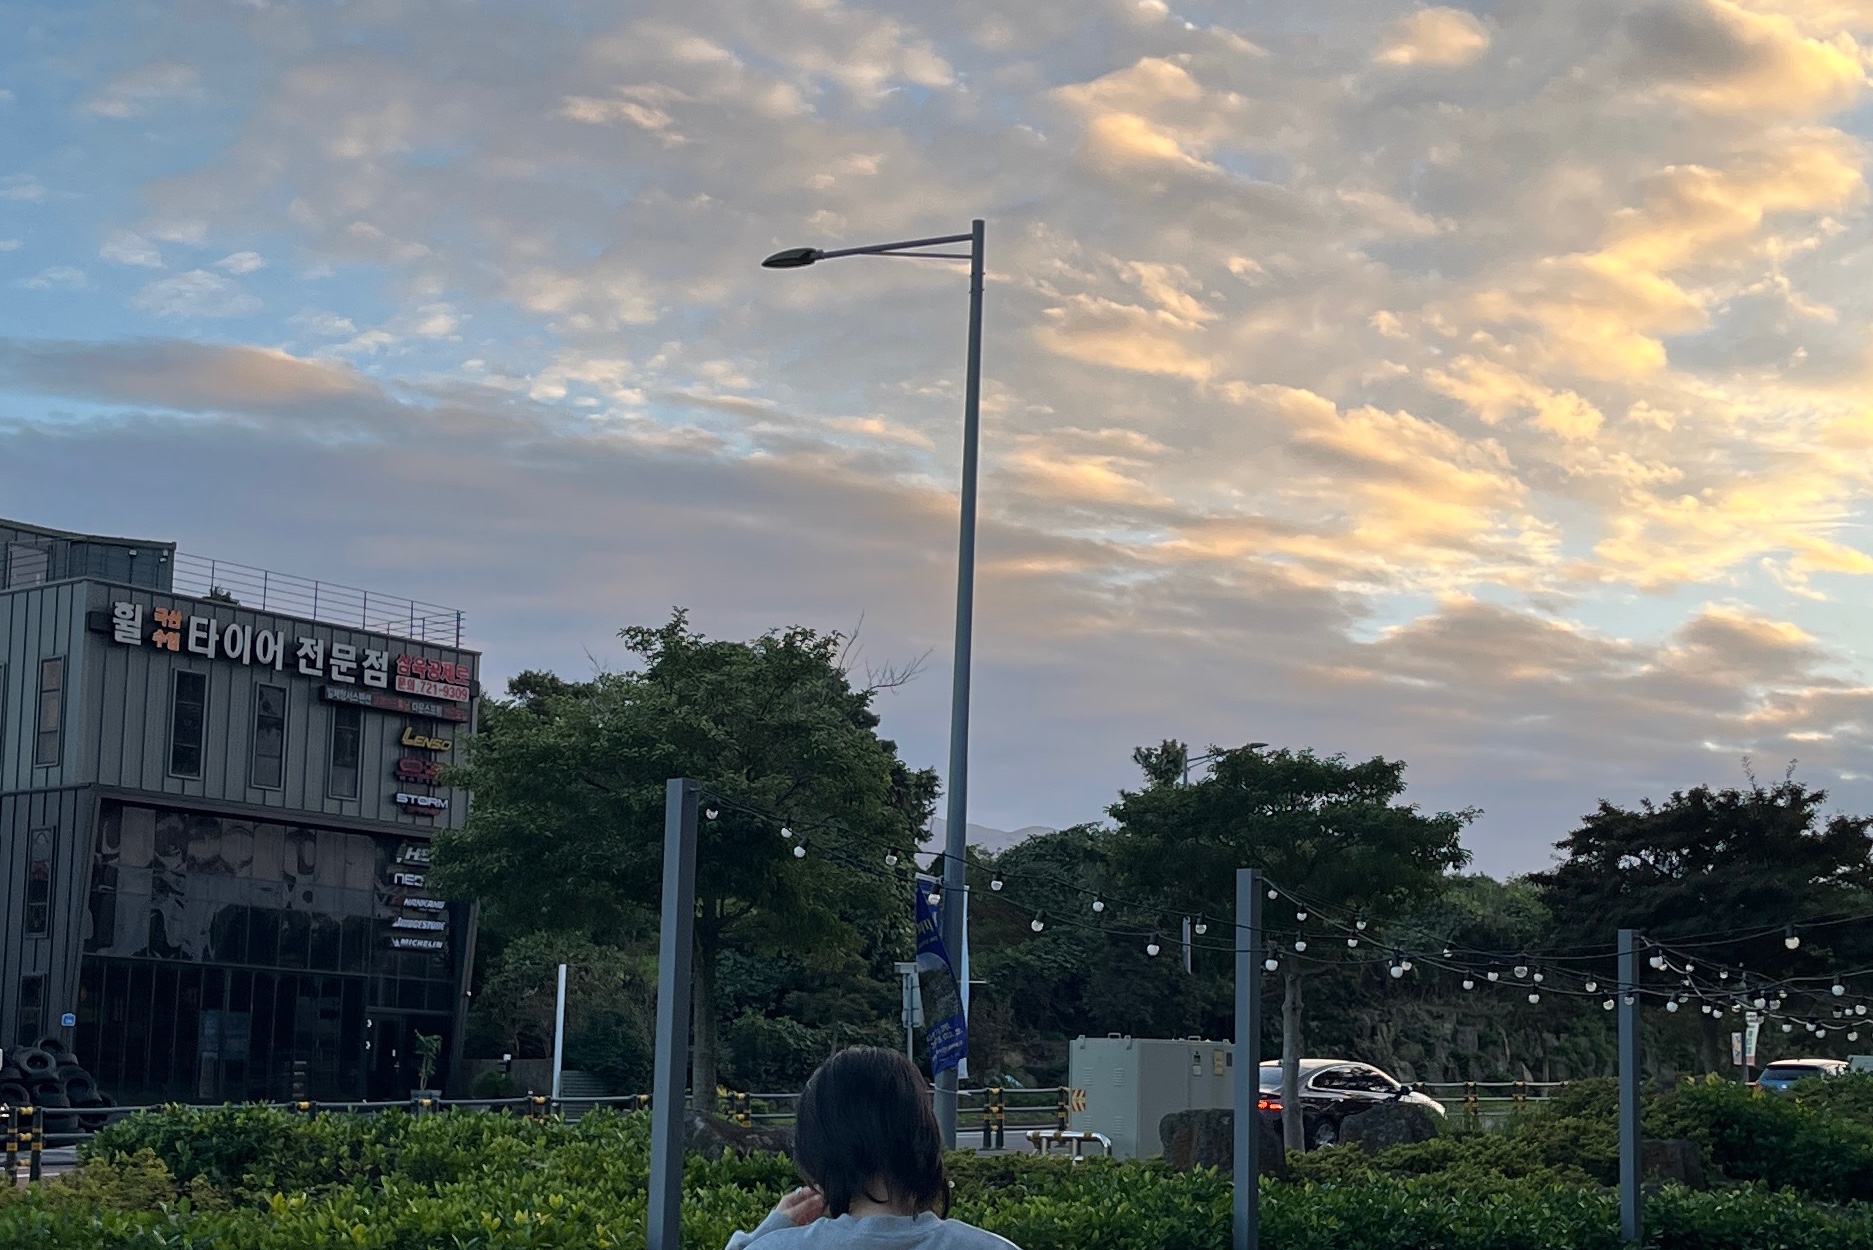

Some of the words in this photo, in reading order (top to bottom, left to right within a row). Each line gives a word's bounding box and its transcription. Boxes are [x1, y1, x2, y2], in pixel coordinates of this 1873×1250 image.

[112, 601, 144, 646] 휠
[187, 615, 286, 671] 타이어
[296, 636, 389, 689] 전문점
[395, 653, 471, 686] 삼육공제로
[420, 680, 468, 700] 721-9309
[401, 726, 453, 751] LENSO
[396, 792, 449, 809] STORM
[400, 937, 444, 949] MICHELIN
